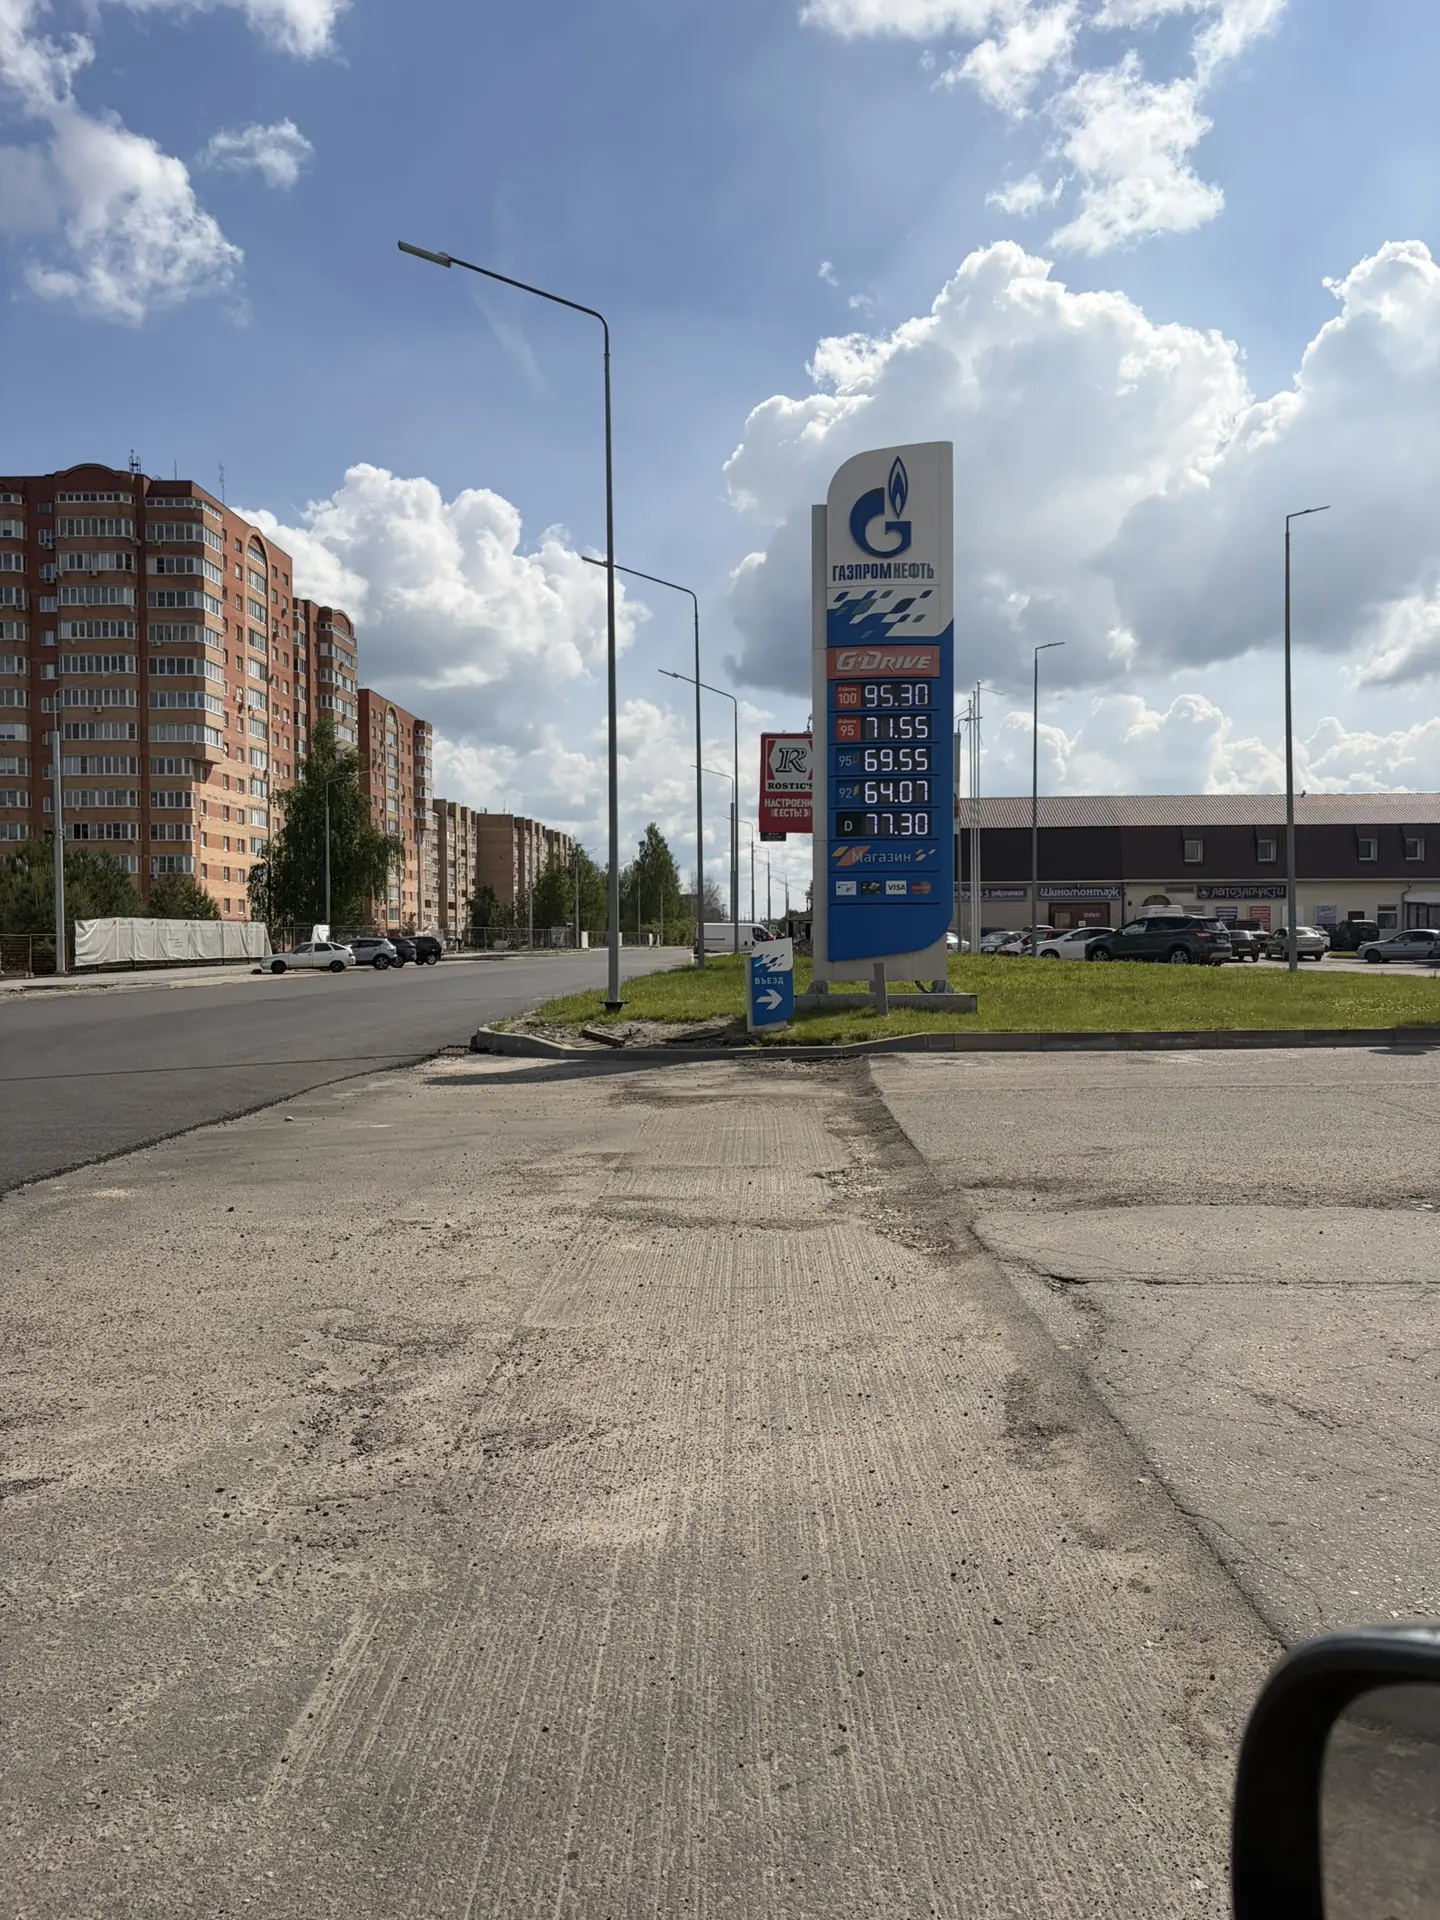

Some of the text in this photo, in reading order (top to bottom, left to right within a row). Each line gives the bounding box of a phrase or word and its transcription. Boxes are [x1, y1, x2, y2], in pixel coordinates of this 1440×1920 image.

[832, 562, 935, 582] ГАЗПРОМНЕФТЬ
[838, 684, 929, 707] 100 95.30
[840, 716, 928, 739] 95 71.55
[838, 748, 928, 772] 95 69.55
[838, 780, 928, 804] 92 64.07
[844, 813, 928, 836] D 77.30
[852, 850, 911, 863] Магазин
[1040, 886, 1120, 899] Шиномонтаж
[1211, 886, 1285, 898] АВТОЗАПЧАСТИ
[754, 977, 785, 985] ВЪЕЗД
